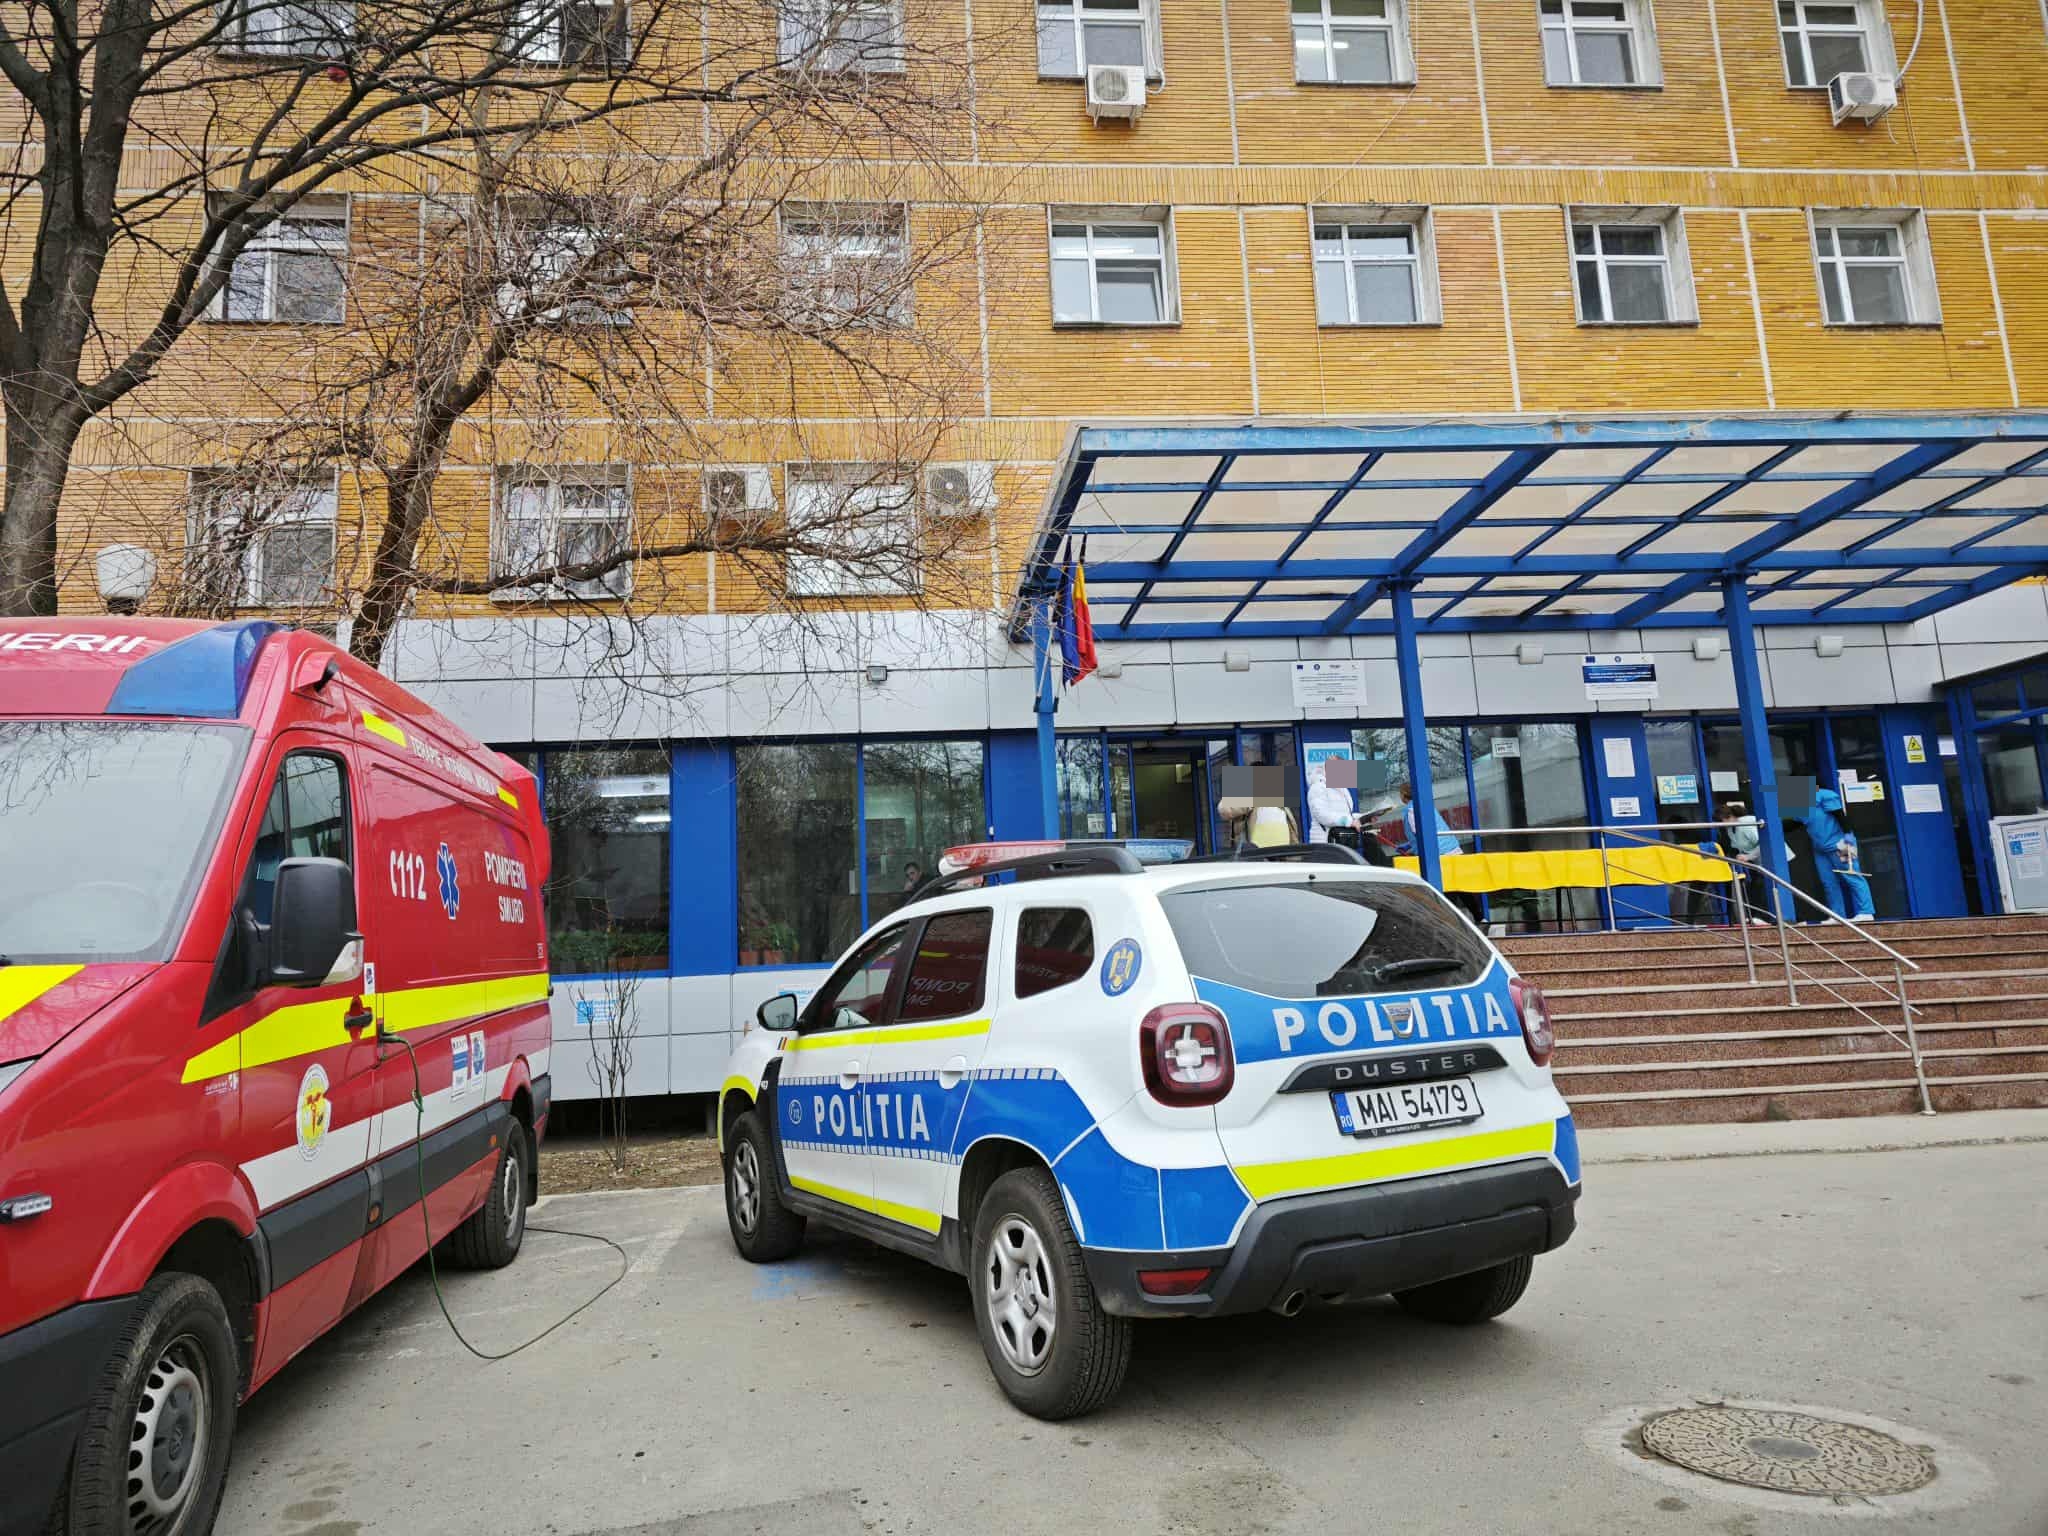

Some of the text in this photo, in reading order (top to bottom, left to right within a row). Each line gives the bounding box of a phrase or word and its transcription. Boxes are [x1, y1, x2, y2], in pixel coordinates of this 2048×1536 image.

[1272, 992, 1509, 1052] POLITIA
[1335, 1053, 1477, 1081] DUSTER
[813, 1094, 931, 1142] POLITIA
[1340, 1115, 1353, 1128] RO
[1356, 1084, 1468, 1125] MAI 54179
